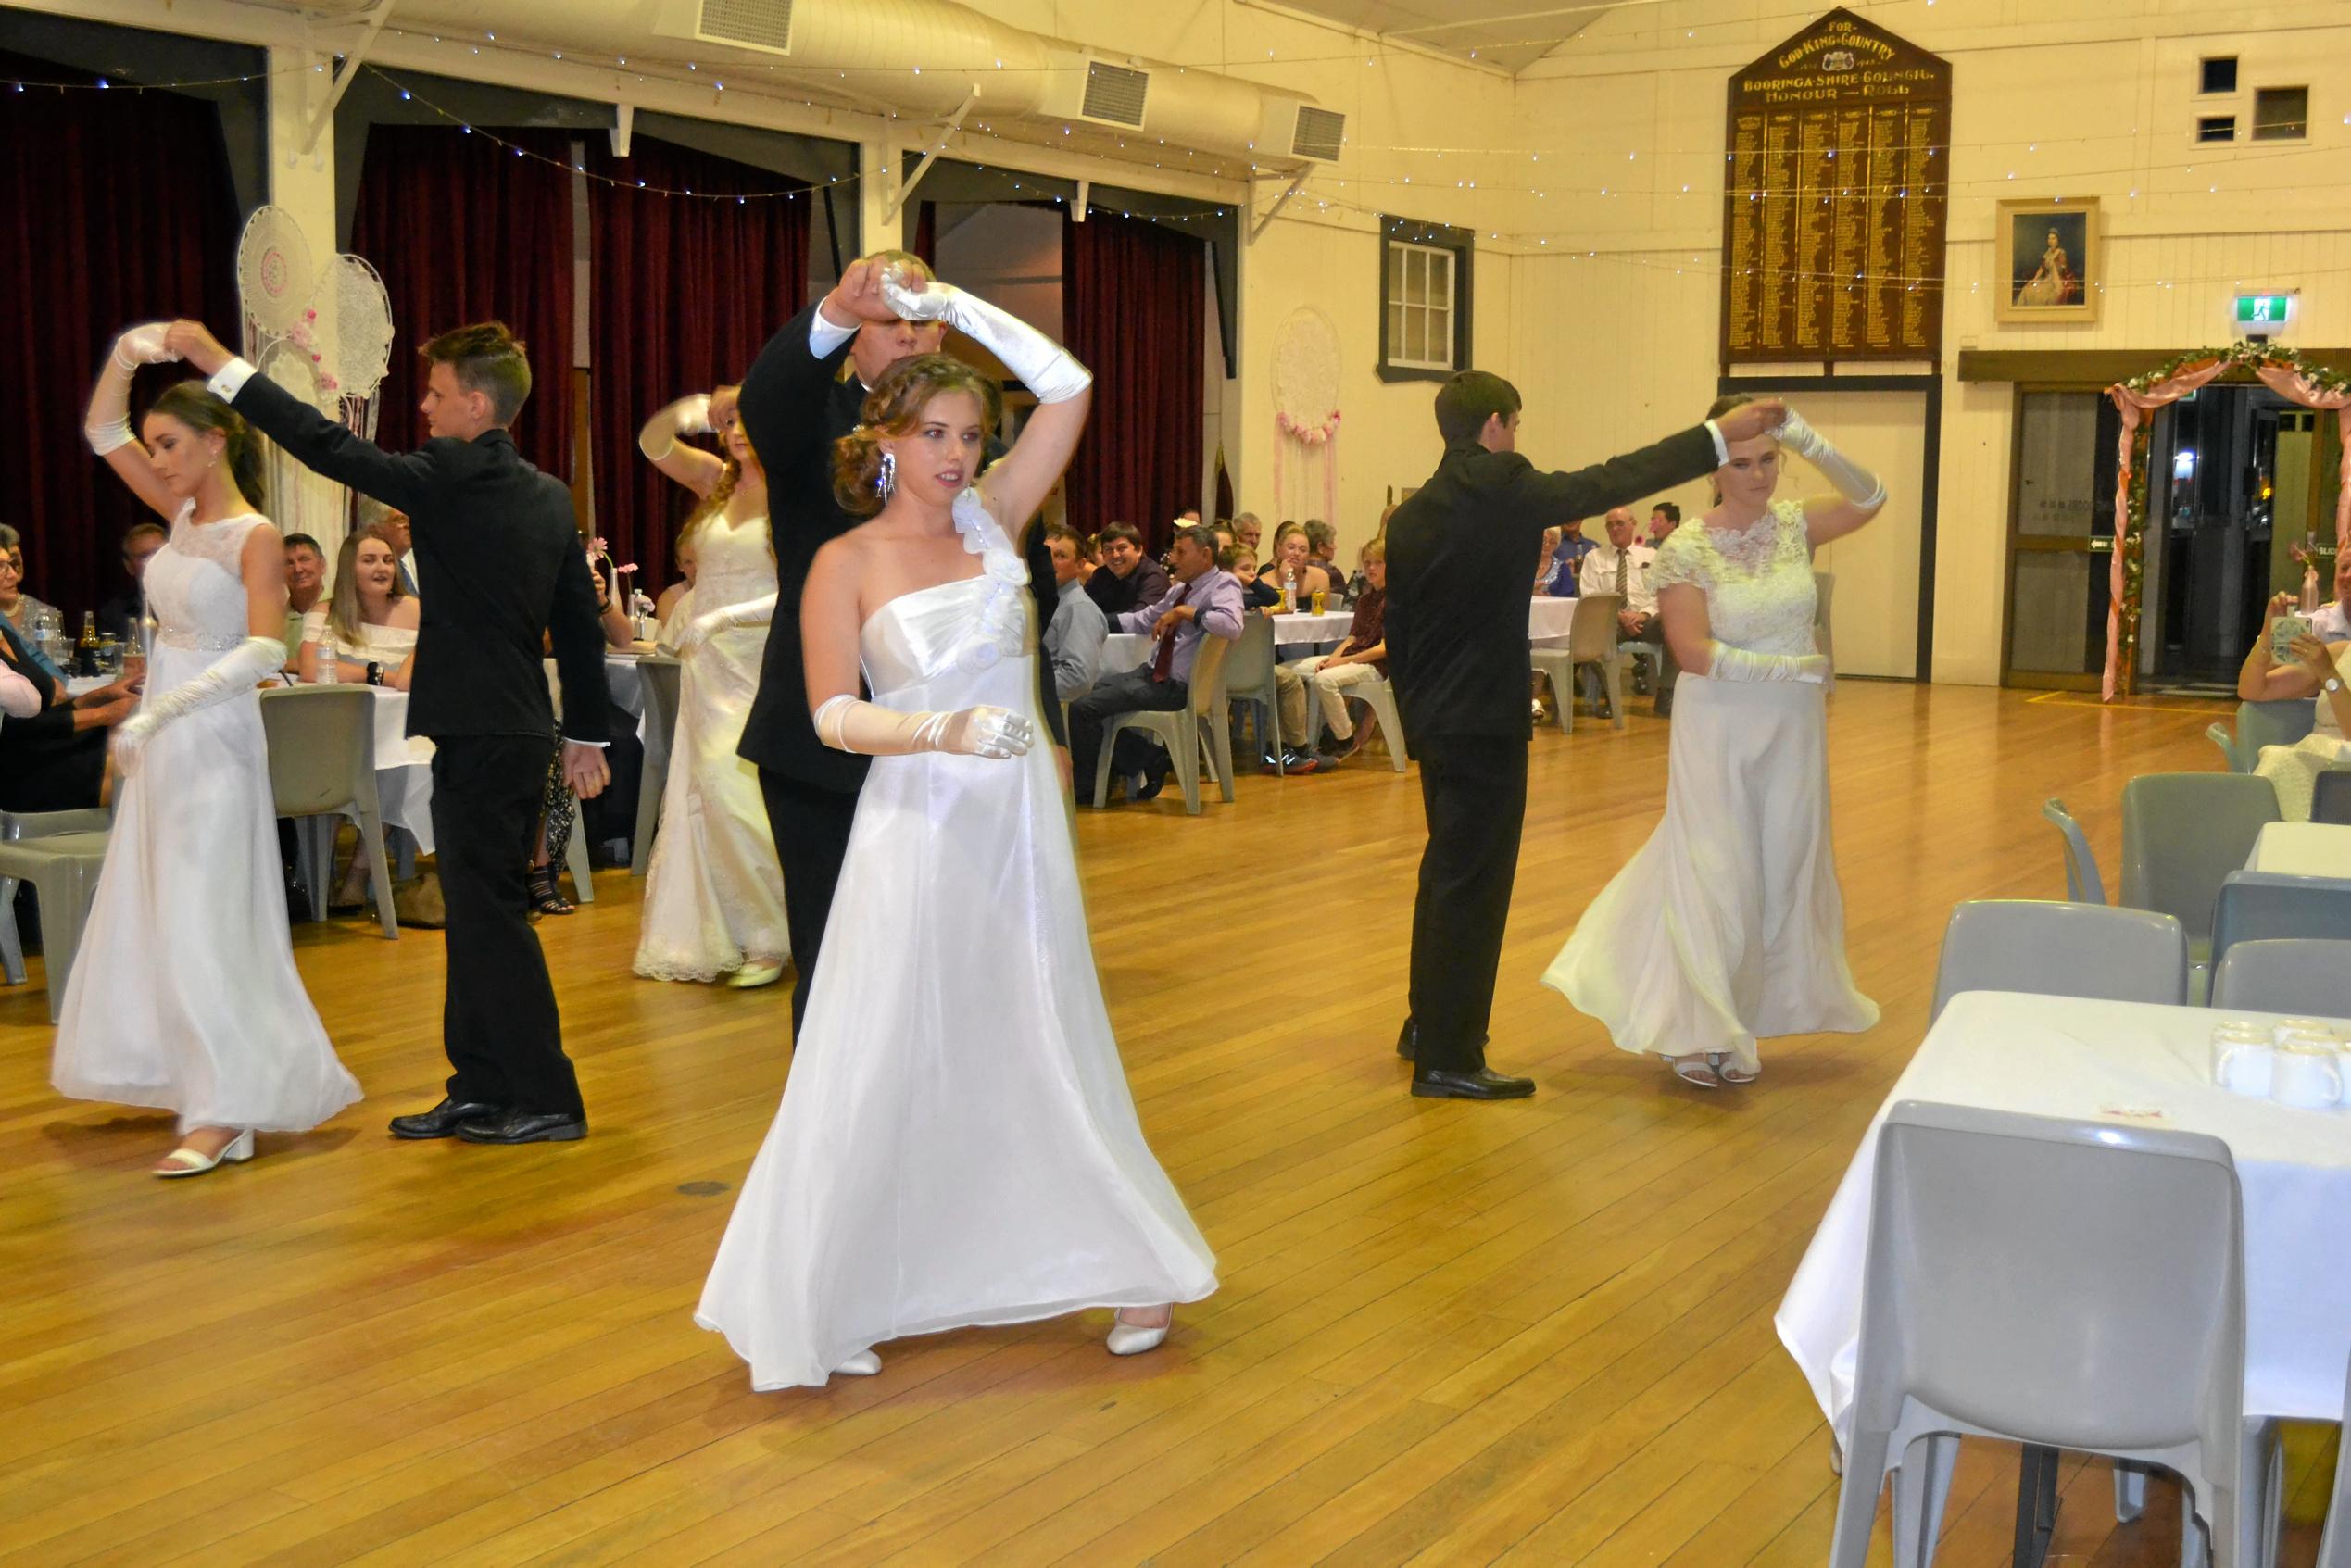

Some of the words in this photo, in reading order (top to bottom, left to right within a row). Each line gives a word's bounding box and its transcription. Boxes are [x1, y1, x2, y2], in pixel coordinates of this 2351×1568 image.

[1743, 77, 1814, 92] BOORINGA
[1816, 74, 1859, 86] SHIRE
[1766, 88, 1838, 103] HONOUR
